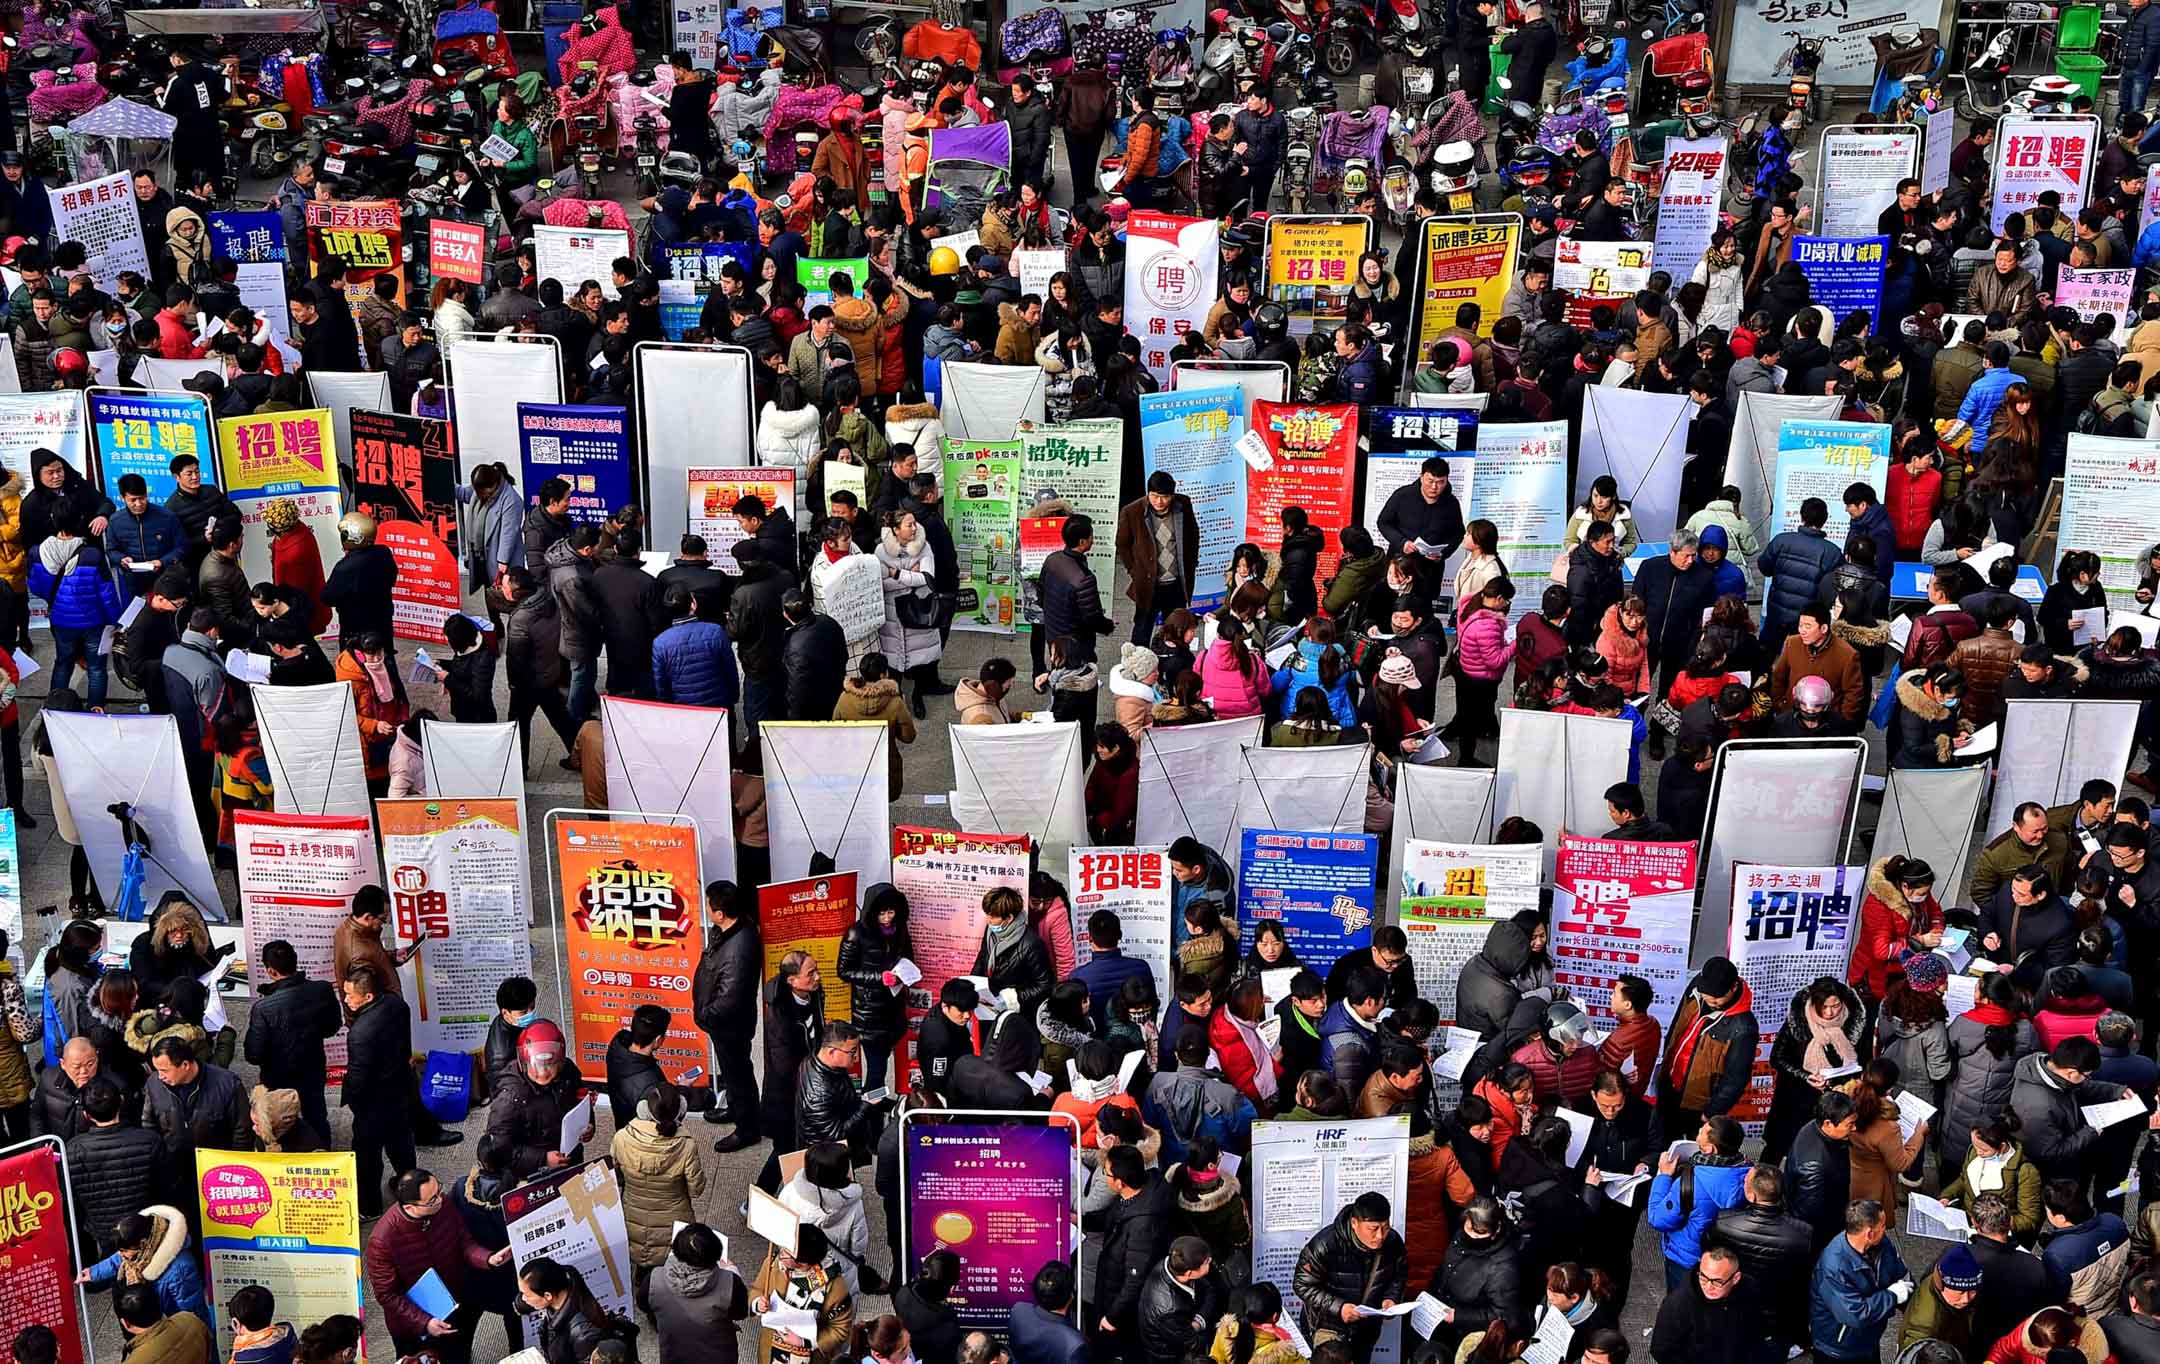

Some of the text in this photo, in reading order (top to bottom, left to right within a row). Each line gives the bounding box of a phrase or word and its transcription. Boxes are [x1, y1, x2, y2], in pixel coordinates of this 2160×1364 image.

[2006, 136, 2086, 167] 招聘
[1665, 151, 1725, 180] 招聘
[61, 179, 129, 212] 招聘启示
[2002, 191, 2079, 204] 生鲜水超市
[303, 205, 396, 228] 汇友投资
[225, 225, 275, 262] 招聘
[320, 228, 391, 259] 诚聘
[1431, 225, 1509, 250] 诚聘英才
[433, 241, 478, 263] 年轻人
[1156, 266, 1186, 294] 聘
[1287, 258, 1346, 281] 招聘
[2078, 300, 2125, 312] 长期招聘
[2090, 288, 2129, 299] 服务中心
[1148, 317, 1192, 336] 保安
[1184, 409, 1230, 442] 招聘
[1282, 417, 1334, 444] 招聘
[1391, 415, 1459, 452] 招聘
[112, 418, 199, 460] 招聘
[236, 418, 324, 473] 招聘
[1520, 441, 1547, 457] 诚聘
[1027, 437, 1110, 468] 招贤纳士
[1277, 448, 1328, 461] Recruitment
[1824, 444, 1873, 478] 招聘
[355, 436, 425, 503] 招聘
[288, 843, 356, 860] 去悬赏招聘网
[902, 832, 1022, 856] 招聘 加入我们
[397, 867, 422, 891] 诚
[925, 859, 1025, 877] 滁州市万正电气有限公司
[1078, 853, 1162, 892] 招聘
[586, 867, 677, 910] 招贤
[1747, 873, 1823, 889] 扬子空调
[1571, 878, 1632, 926] 聘
[1744, 864, 1853, 951] 招聘
[588, 904, 678, 946] 纳士
[1331, 895, 1372, 935] 招聘
[1572, 935, 1601, 948] 长白班
[1567, 948, 1629, 963] 工作岗位
[602, 971, 675, 990] 导购 5名
[1566, 974, 1611, 987] 岗位要
[1316, 1128, 1348, 1141] HRF
[979, 1148, 1001, 1159] 招聘
[257, 1237, 304, 1249] 加入我们
[523, 1218, 567, 1244] 招聘启事
